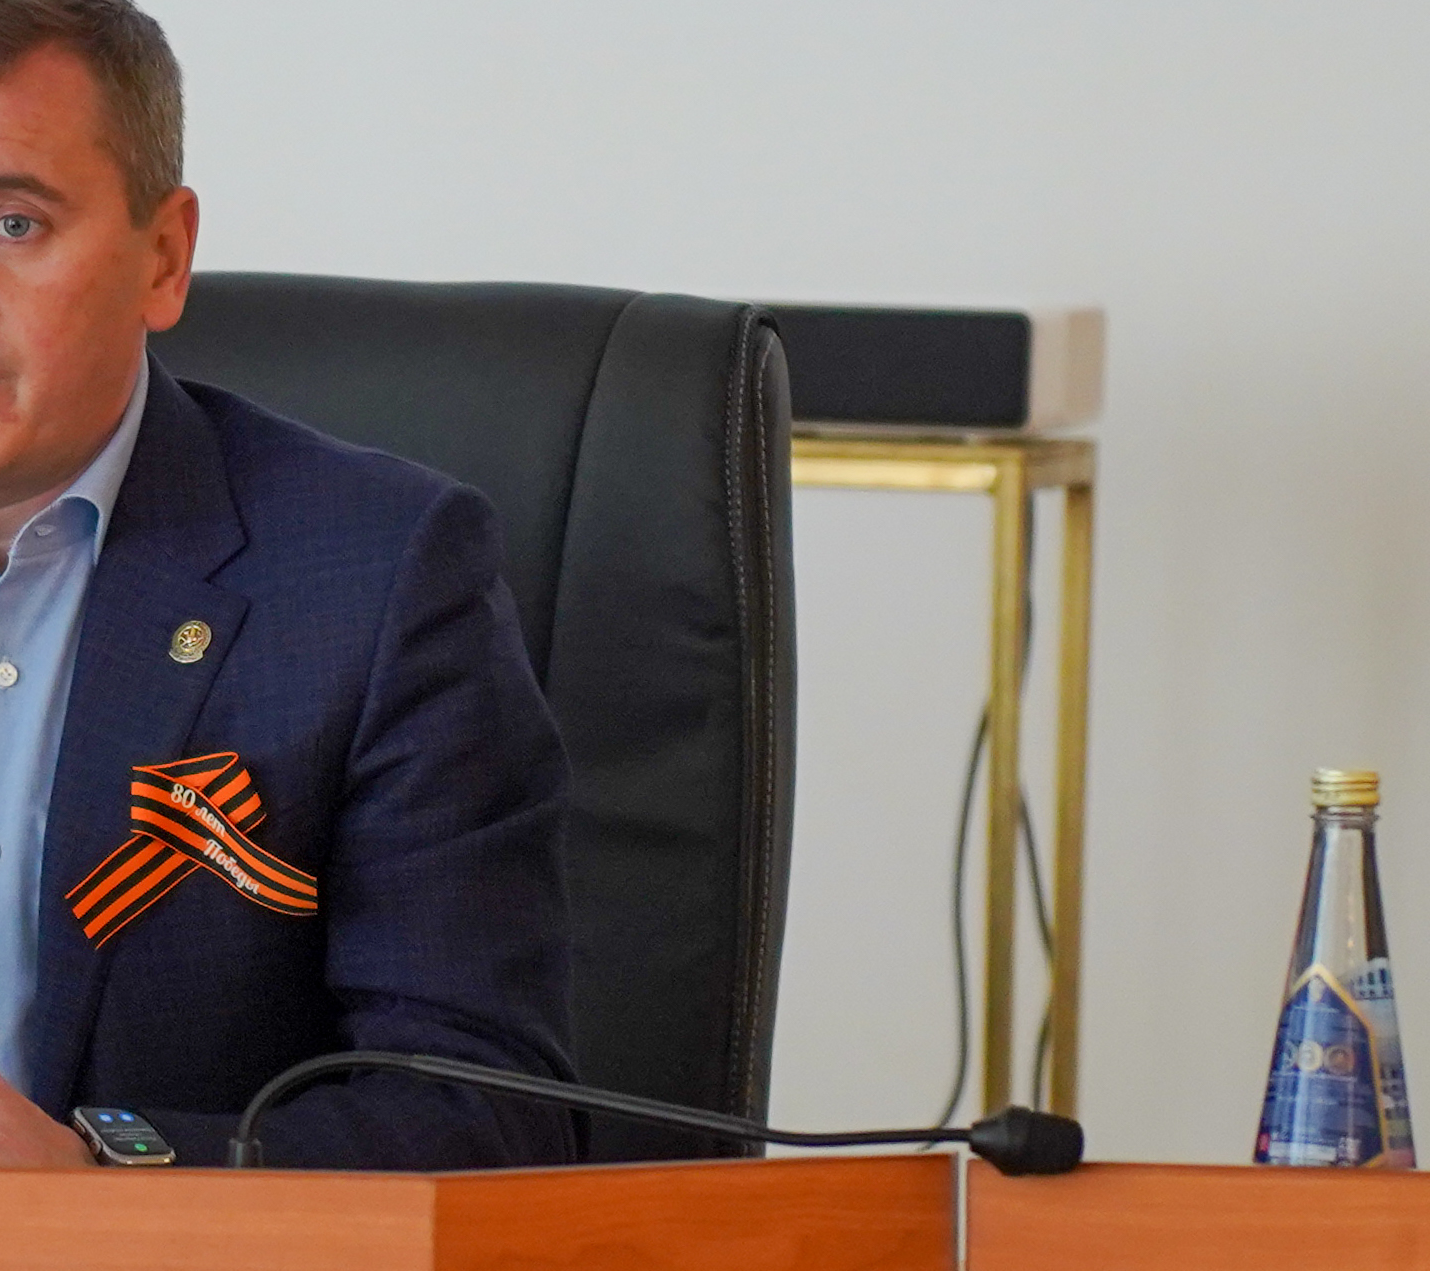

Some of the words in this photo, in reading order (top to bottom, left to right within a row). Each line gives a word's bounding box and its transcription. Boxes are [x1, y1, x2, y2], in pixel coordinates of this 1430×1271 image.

[170, 782, 197, 809] 80
[195, 806, 227, 838] лет
[203, 838, 260, 895] Победы
